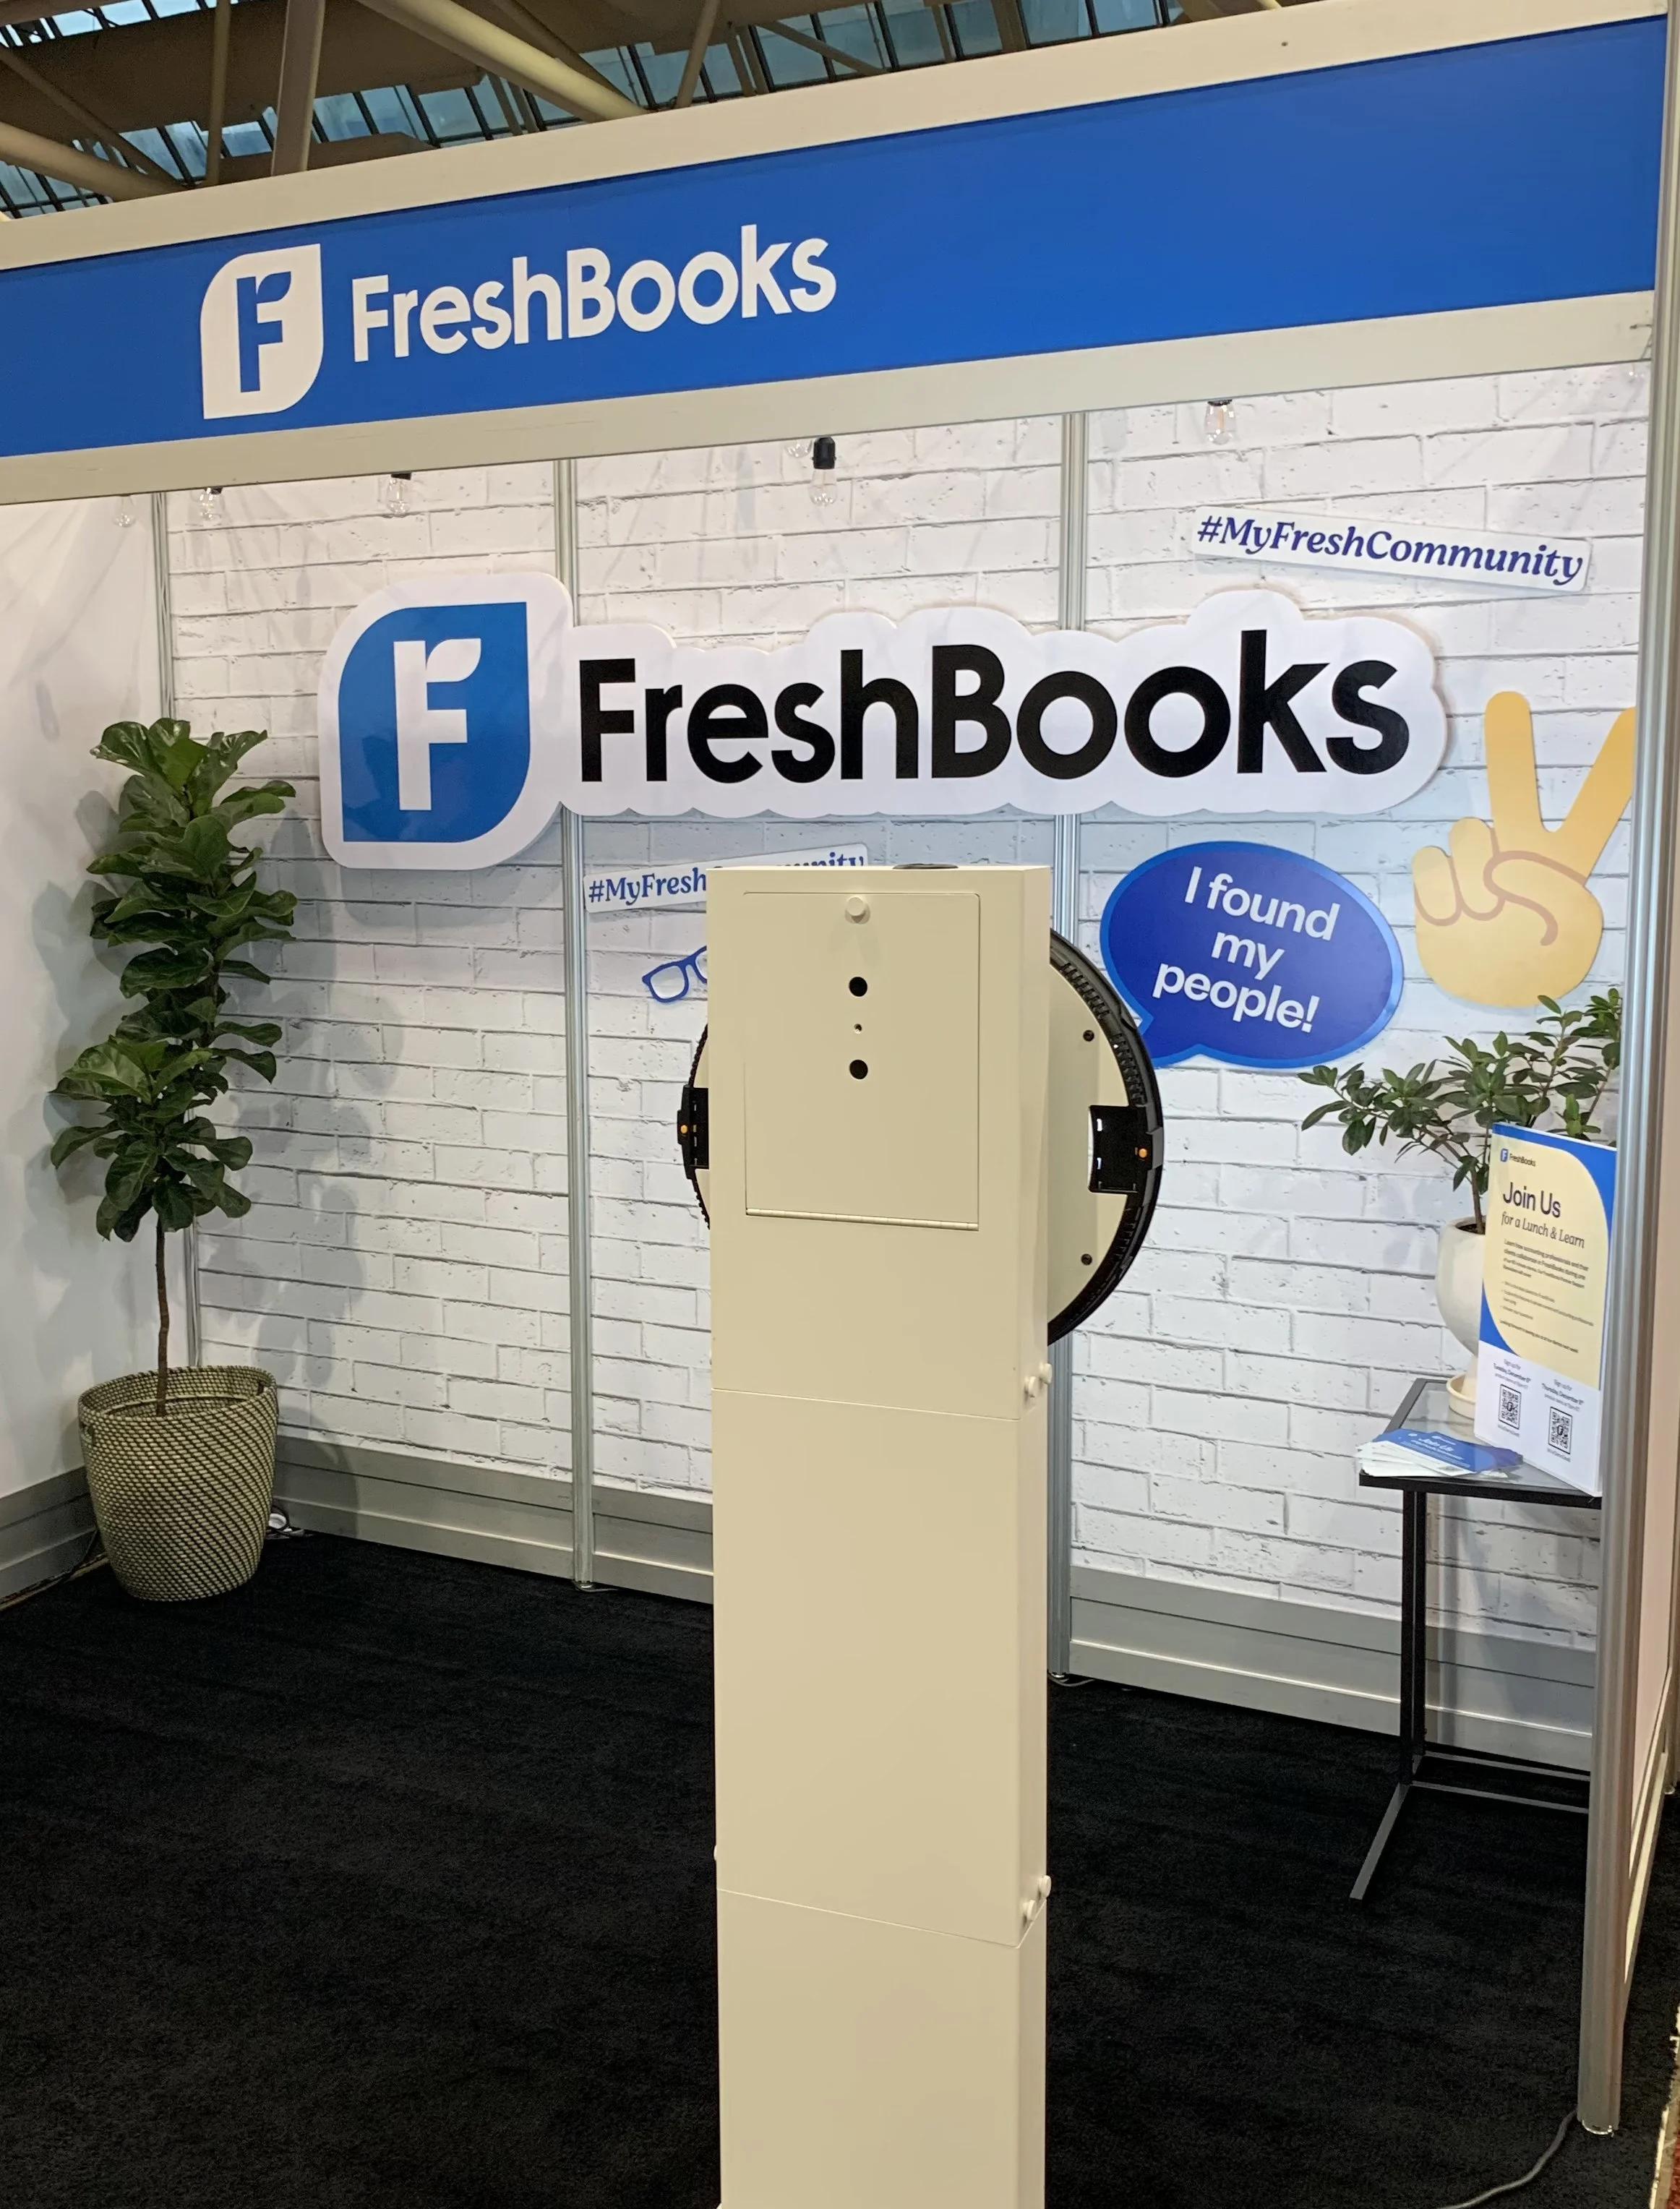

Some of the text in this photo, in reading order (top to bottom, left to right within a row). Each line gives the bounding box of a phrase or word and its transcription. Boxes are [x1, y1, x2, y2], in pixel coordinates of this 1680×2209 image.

[352, 224, 836, 362] FreshBooks
[1197, 515, 1585, 586] #MyFreshCommunity
[579, 630, 1410, 784] FreshBooks
[1185, 867, 1340, 941] I found
[1212, 932, 1285, 980] my
[1152, 964, 1320, 1033] people!
[1501, 1211, 1585, 1248] for a Lunch & Learn
[1502, 1182, 1561, 1218] Join Us
